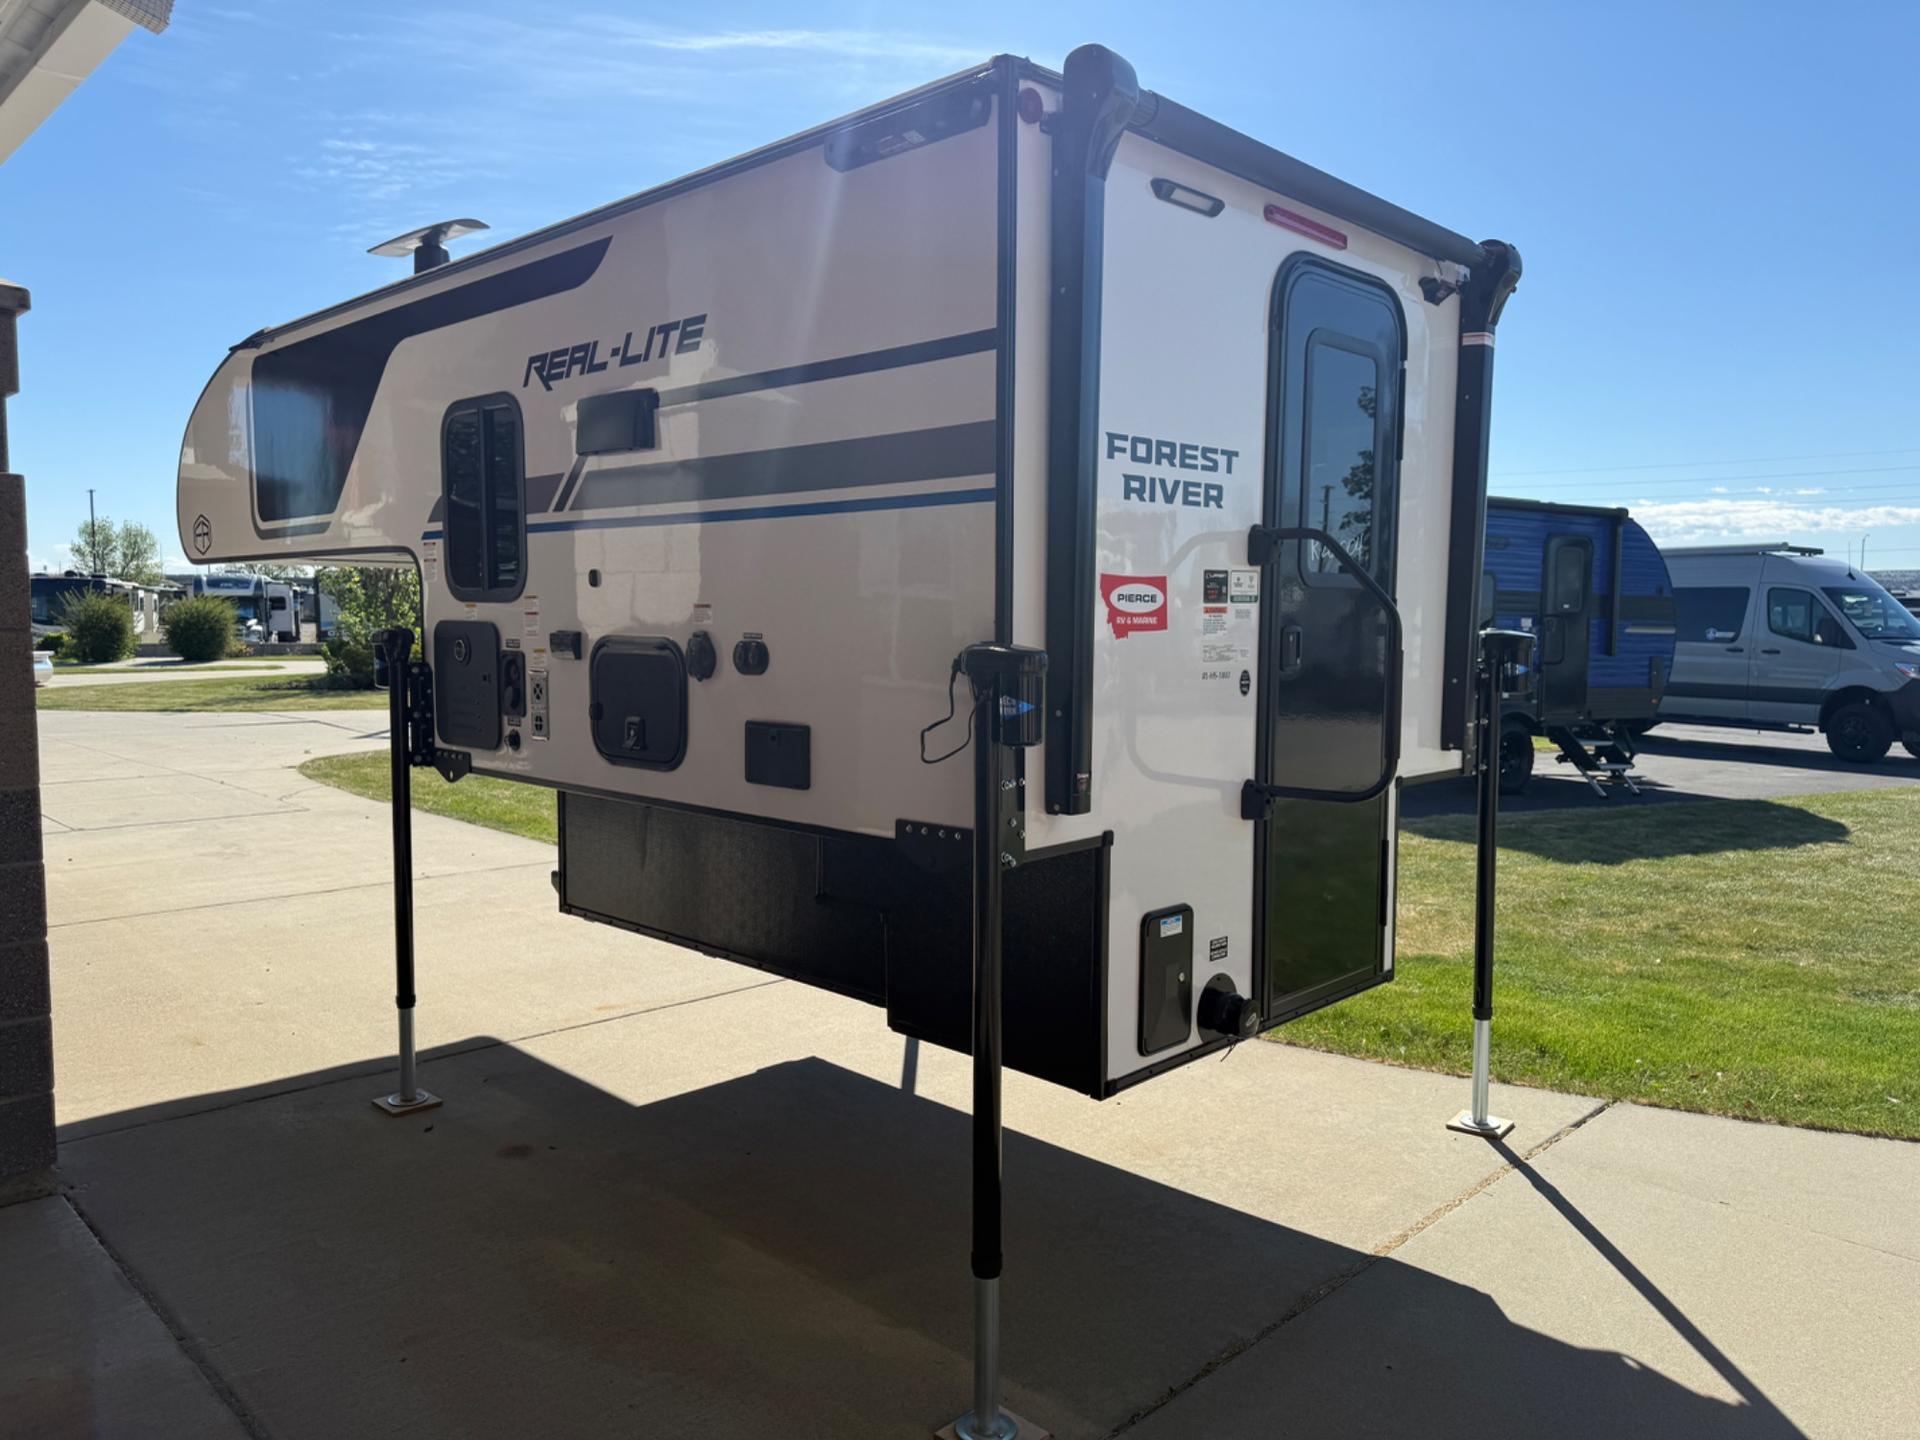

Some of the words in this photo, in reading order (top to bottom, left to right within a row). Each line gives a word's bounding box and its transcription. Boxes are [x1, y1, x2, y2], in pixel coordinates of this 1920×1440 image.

[522, 313, 708, 392] REAL-LITE
[1105, 431, 1240, 475] FOREST
[1122, 473, 1224, 509] RIVER
[1117, 593, 1157, 603] PIERCE
[1116, 616, 1126, 625] RV
[1132, 616, 1158, 625] MARINE
